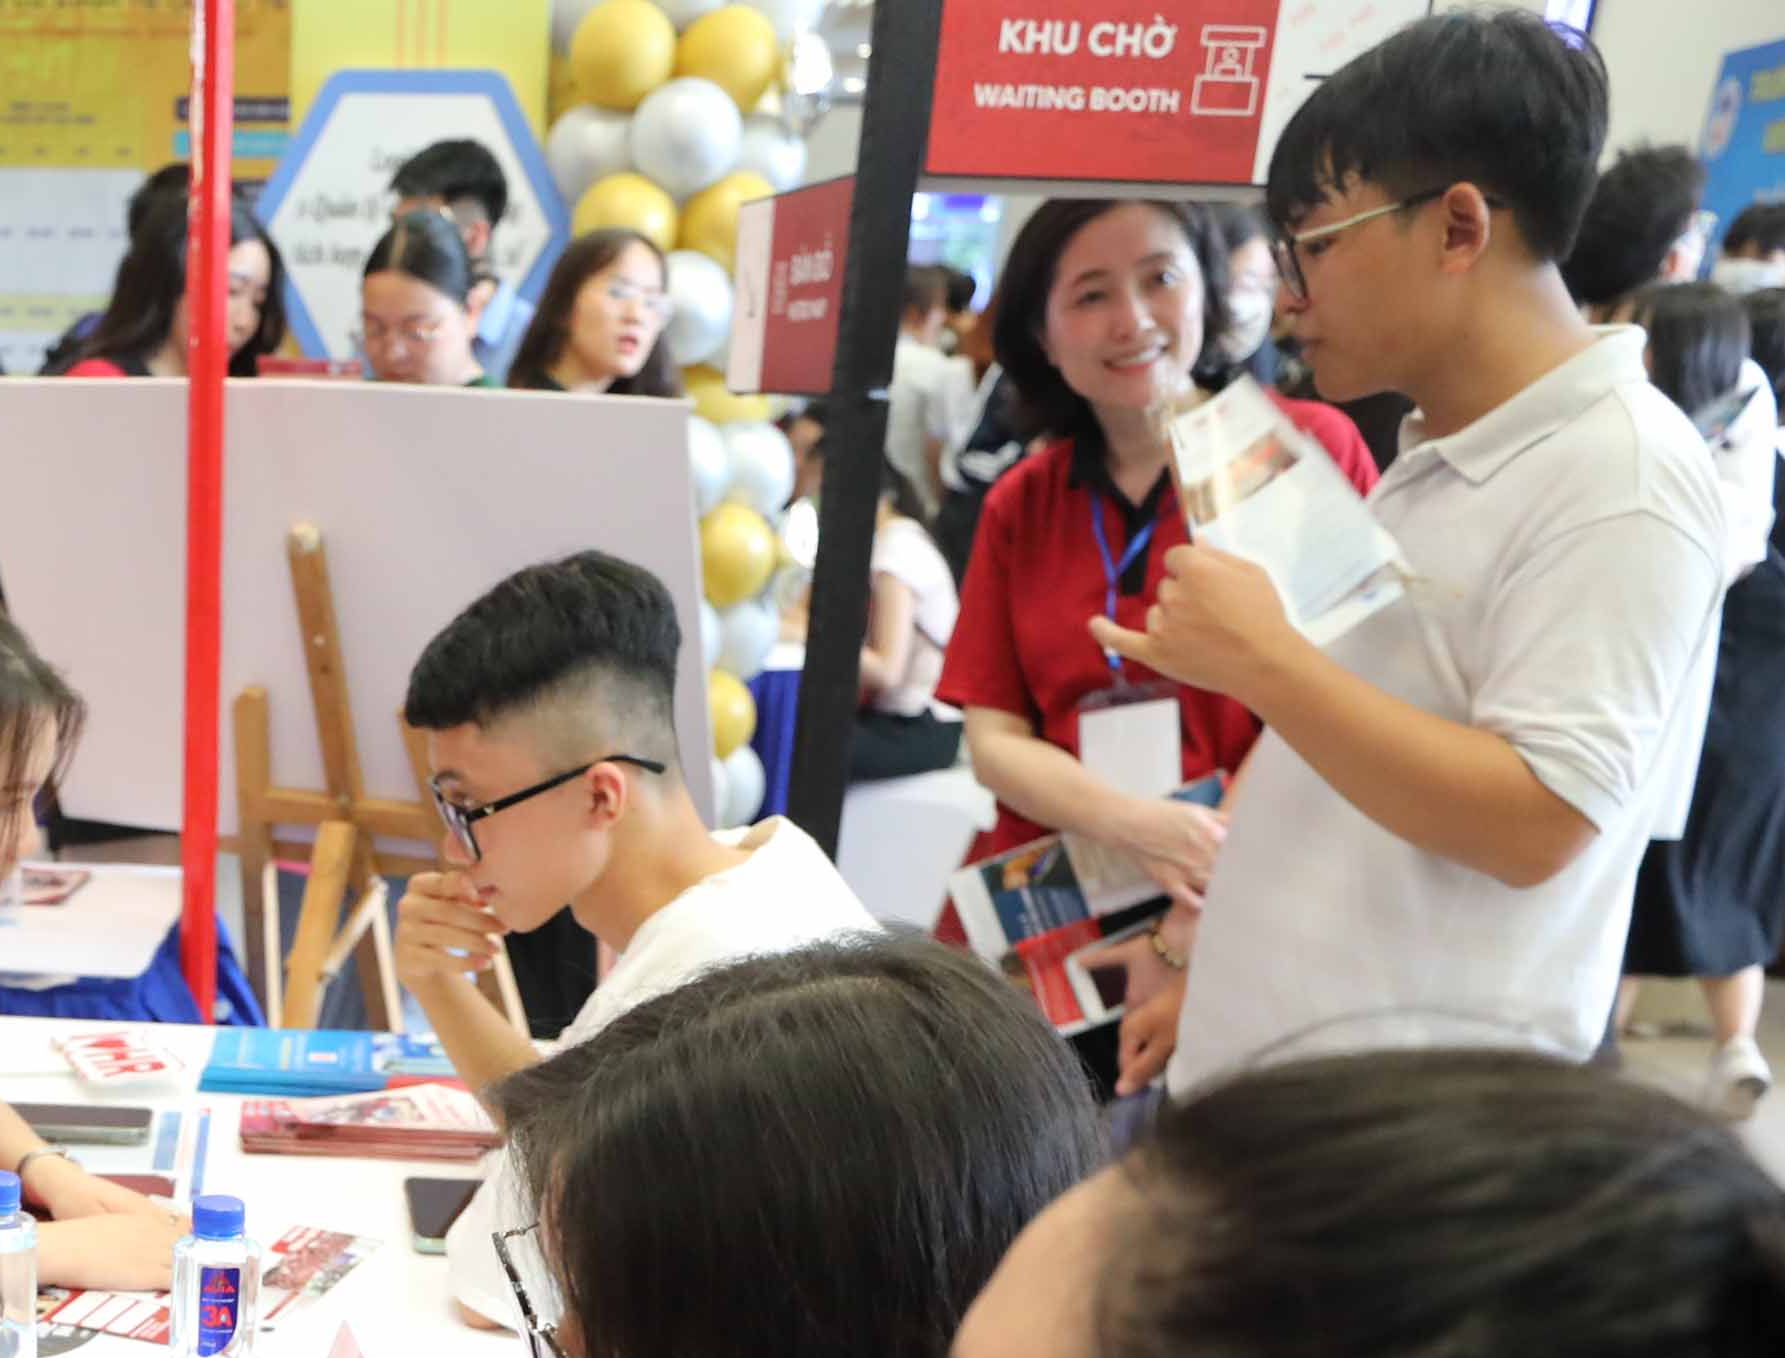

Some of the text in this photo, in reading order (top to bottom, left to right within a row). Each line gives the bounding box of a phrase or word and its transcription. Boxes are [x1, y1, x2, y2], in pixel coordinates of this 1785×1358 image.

[998, 15, 1178, 59] KHU CHỜ
[973, 83, 1180, 114] WAITING BOOTH
[201, 1304, 233, 1328] 3A
